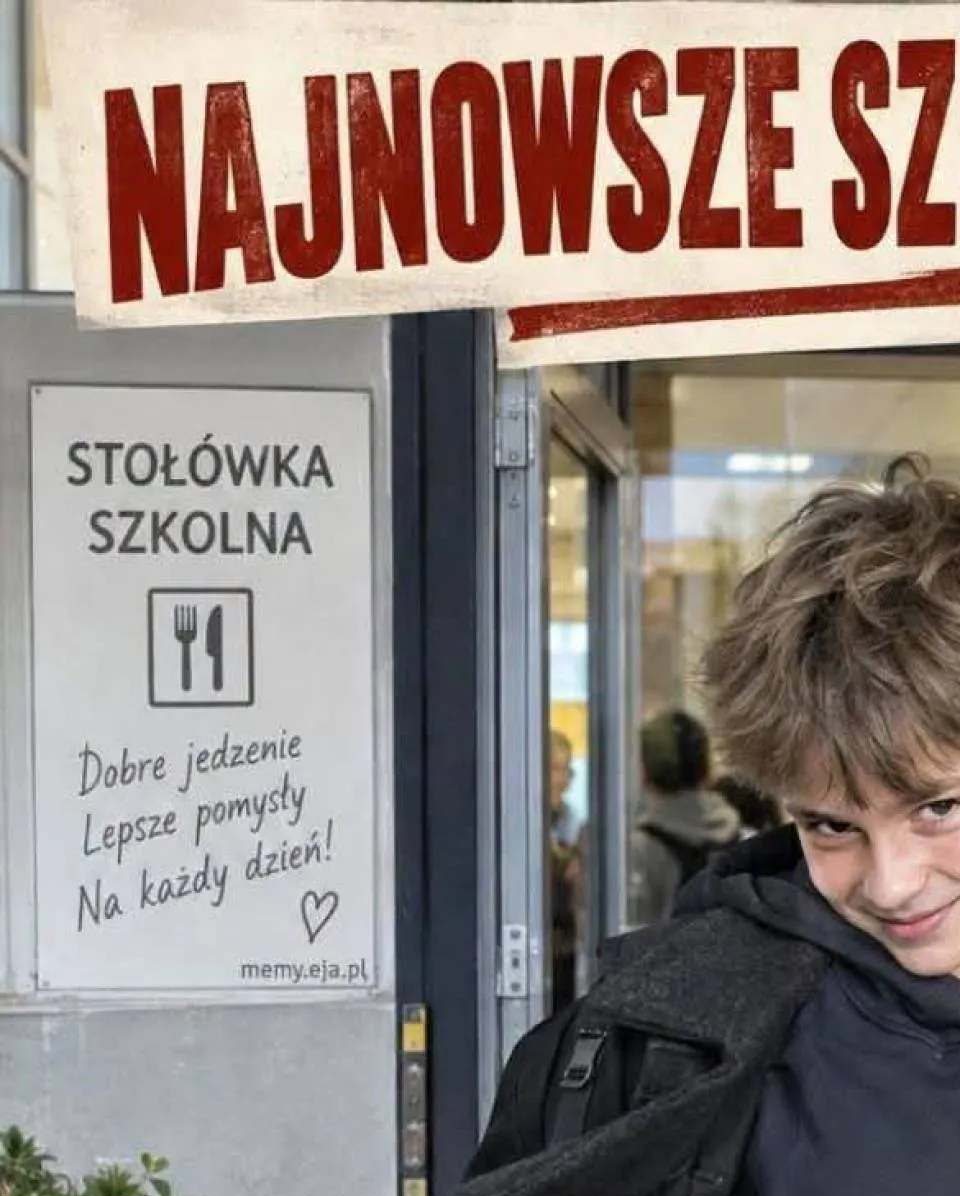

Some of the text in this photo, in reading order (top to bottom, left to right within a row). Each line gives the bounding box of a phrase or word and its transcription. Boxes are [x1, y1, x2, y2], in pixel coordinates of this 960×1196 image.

[66, 432, 334, 489] STOŁÓWKA
[88, 509, 313, 556] SZKOLNA
[78, 729, 303, 797] Dobre jedzenie
[83, 771, 306, 865] Lepsze pomysły
[77, 813, 334, 933] Na każdy dzień!
